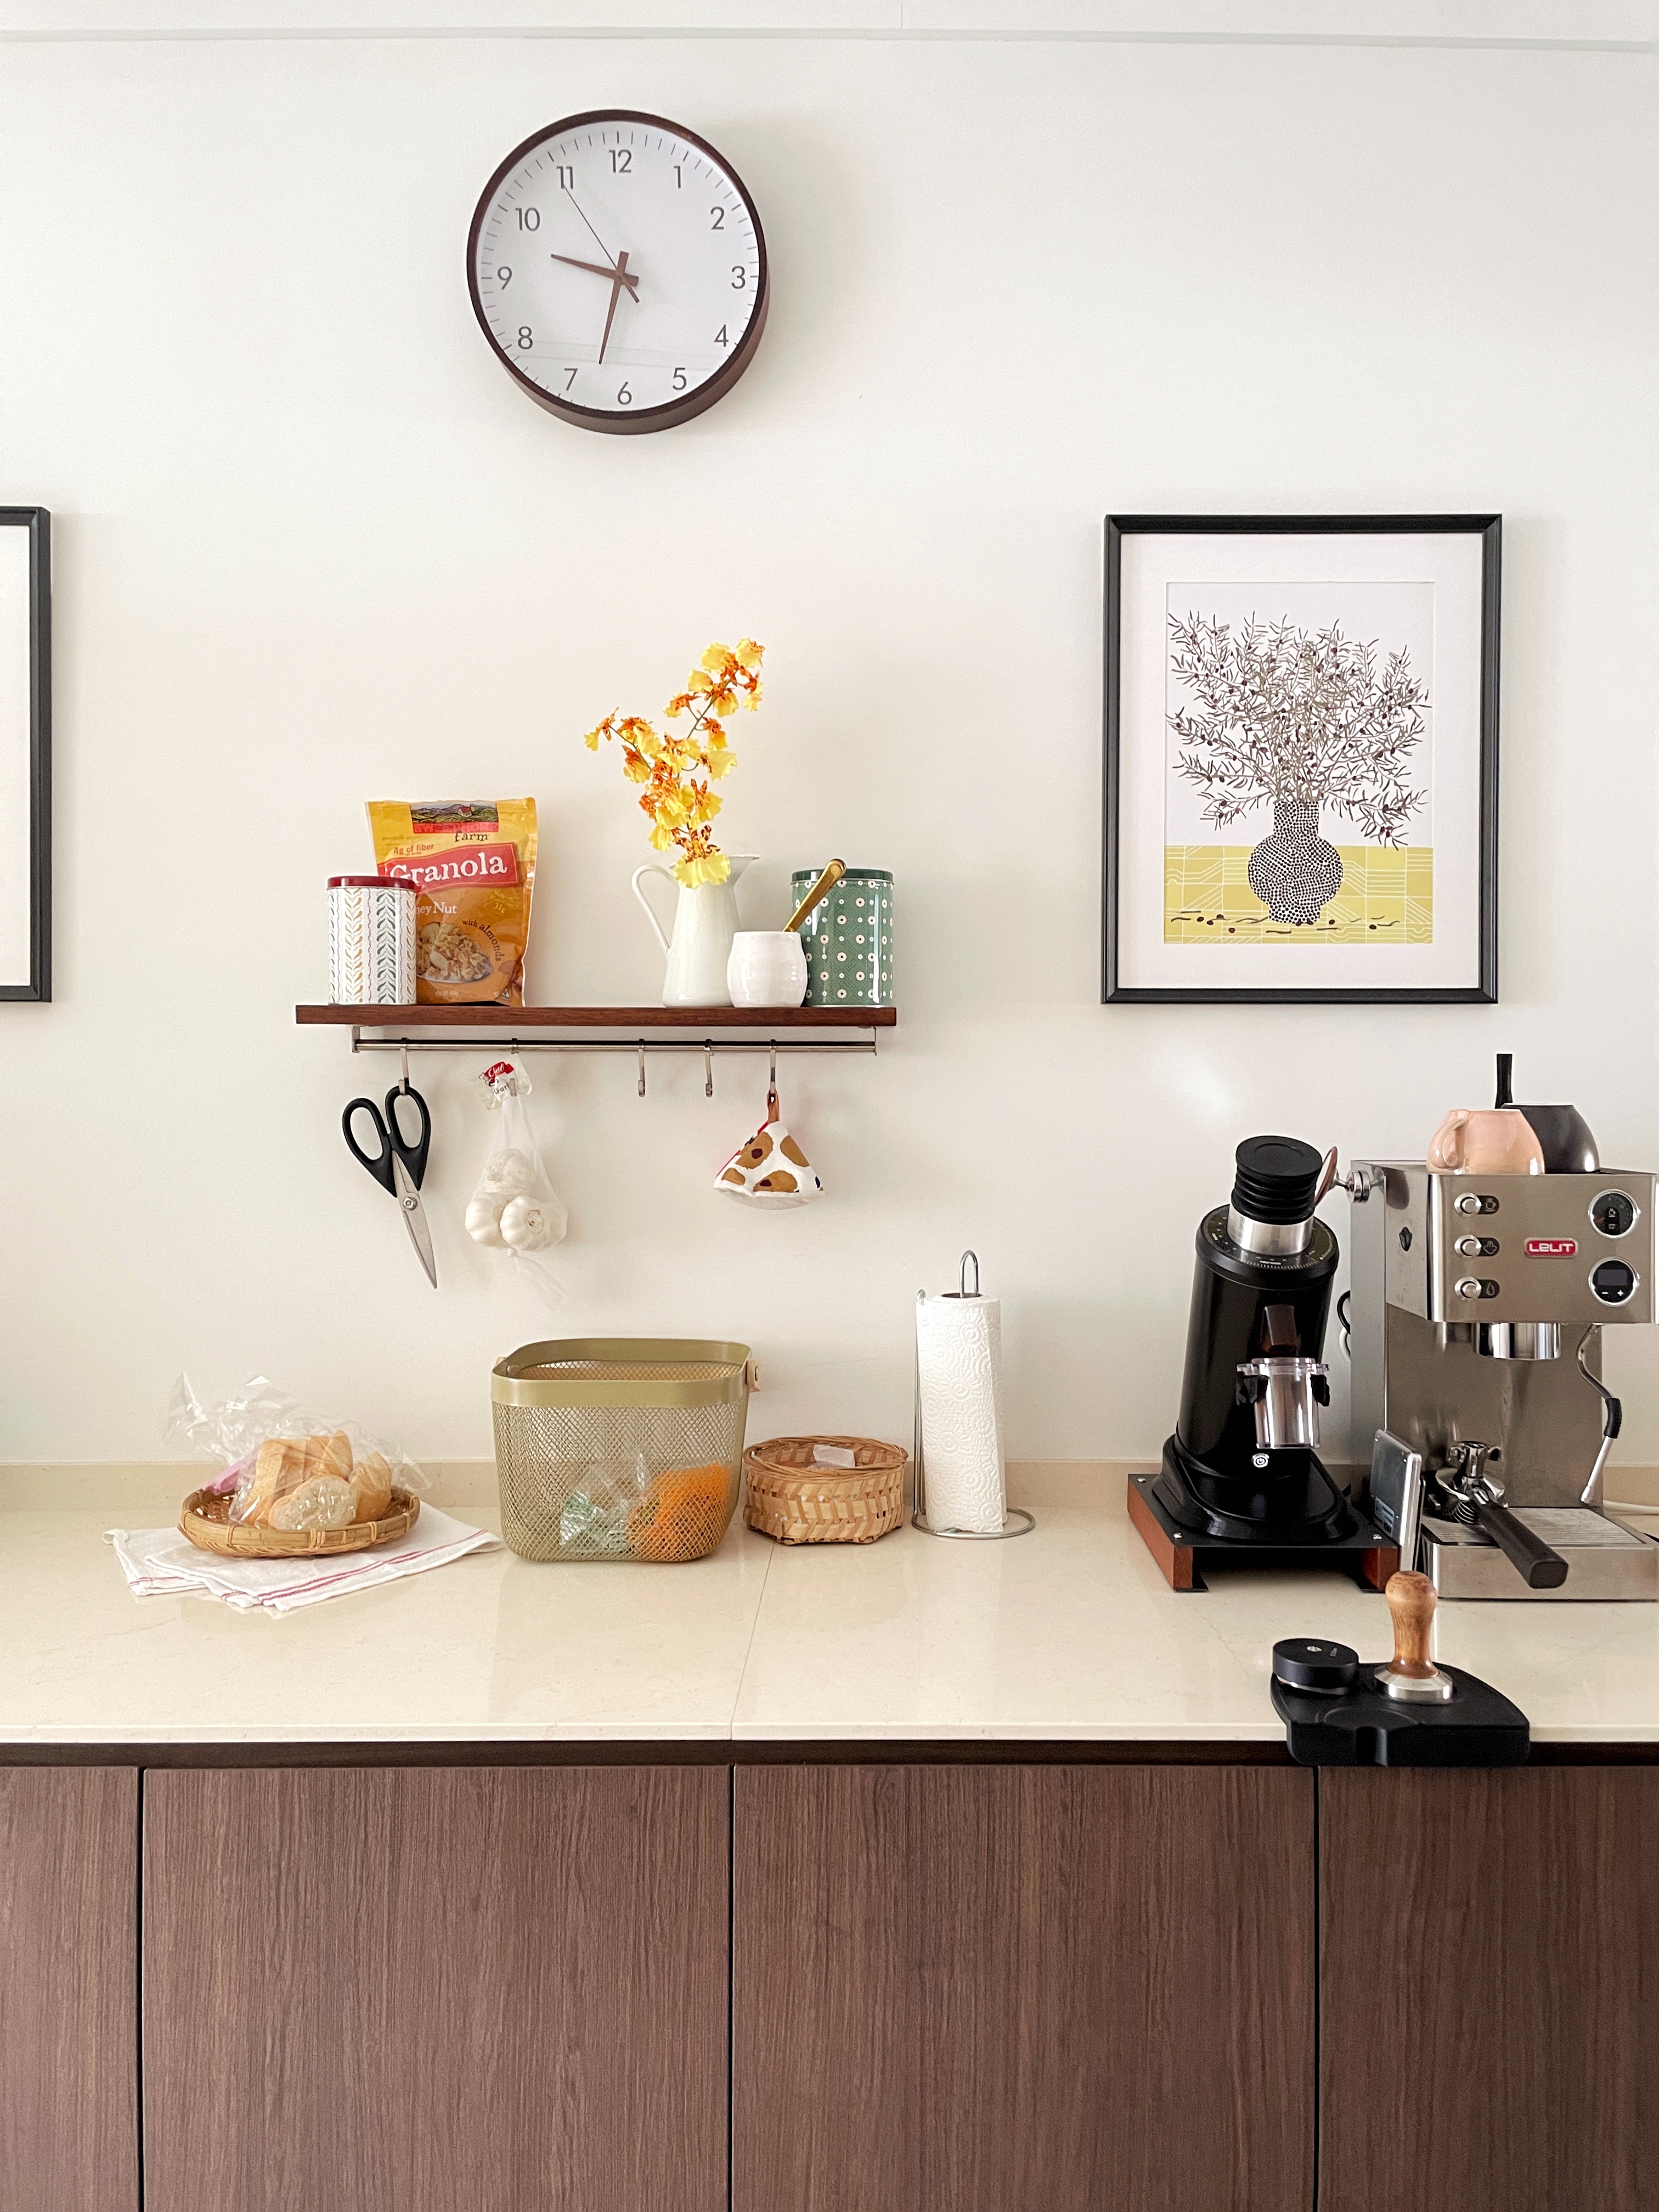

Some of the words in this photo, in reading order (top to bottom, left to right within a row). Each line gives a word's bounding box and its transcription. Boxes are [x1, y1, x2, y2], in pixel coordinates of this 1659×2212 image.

[609, 150, 632, 173] 12
[556, 166, 573, 189] 11
[674, 166, 681, 188] 1
[515, 207, 540, 231] 10
[710, 207, 725, 230] 2
[497, 266, 512, 290] 9
[731, 266, 746, 289] 3
[517, 326, 533, 349] 8
[714, 324, 729, 347] 4
[564, 368, 578, 391] 7
[672, 368, 687, 390] 5
[617, 382, 632, 405] 6
[455, 830, 488, 842] farm
[394, 847, 404, 855] 4g
[390, 852, 507, 884] Granola
[416, 905, 432, 916] ney
[433, 901, 458, 914] Nut
[479, 924, 505, 961] almonds
[488, 1063, 505, 1077] Chef
[494, 1082, 510, 1094] Garl
